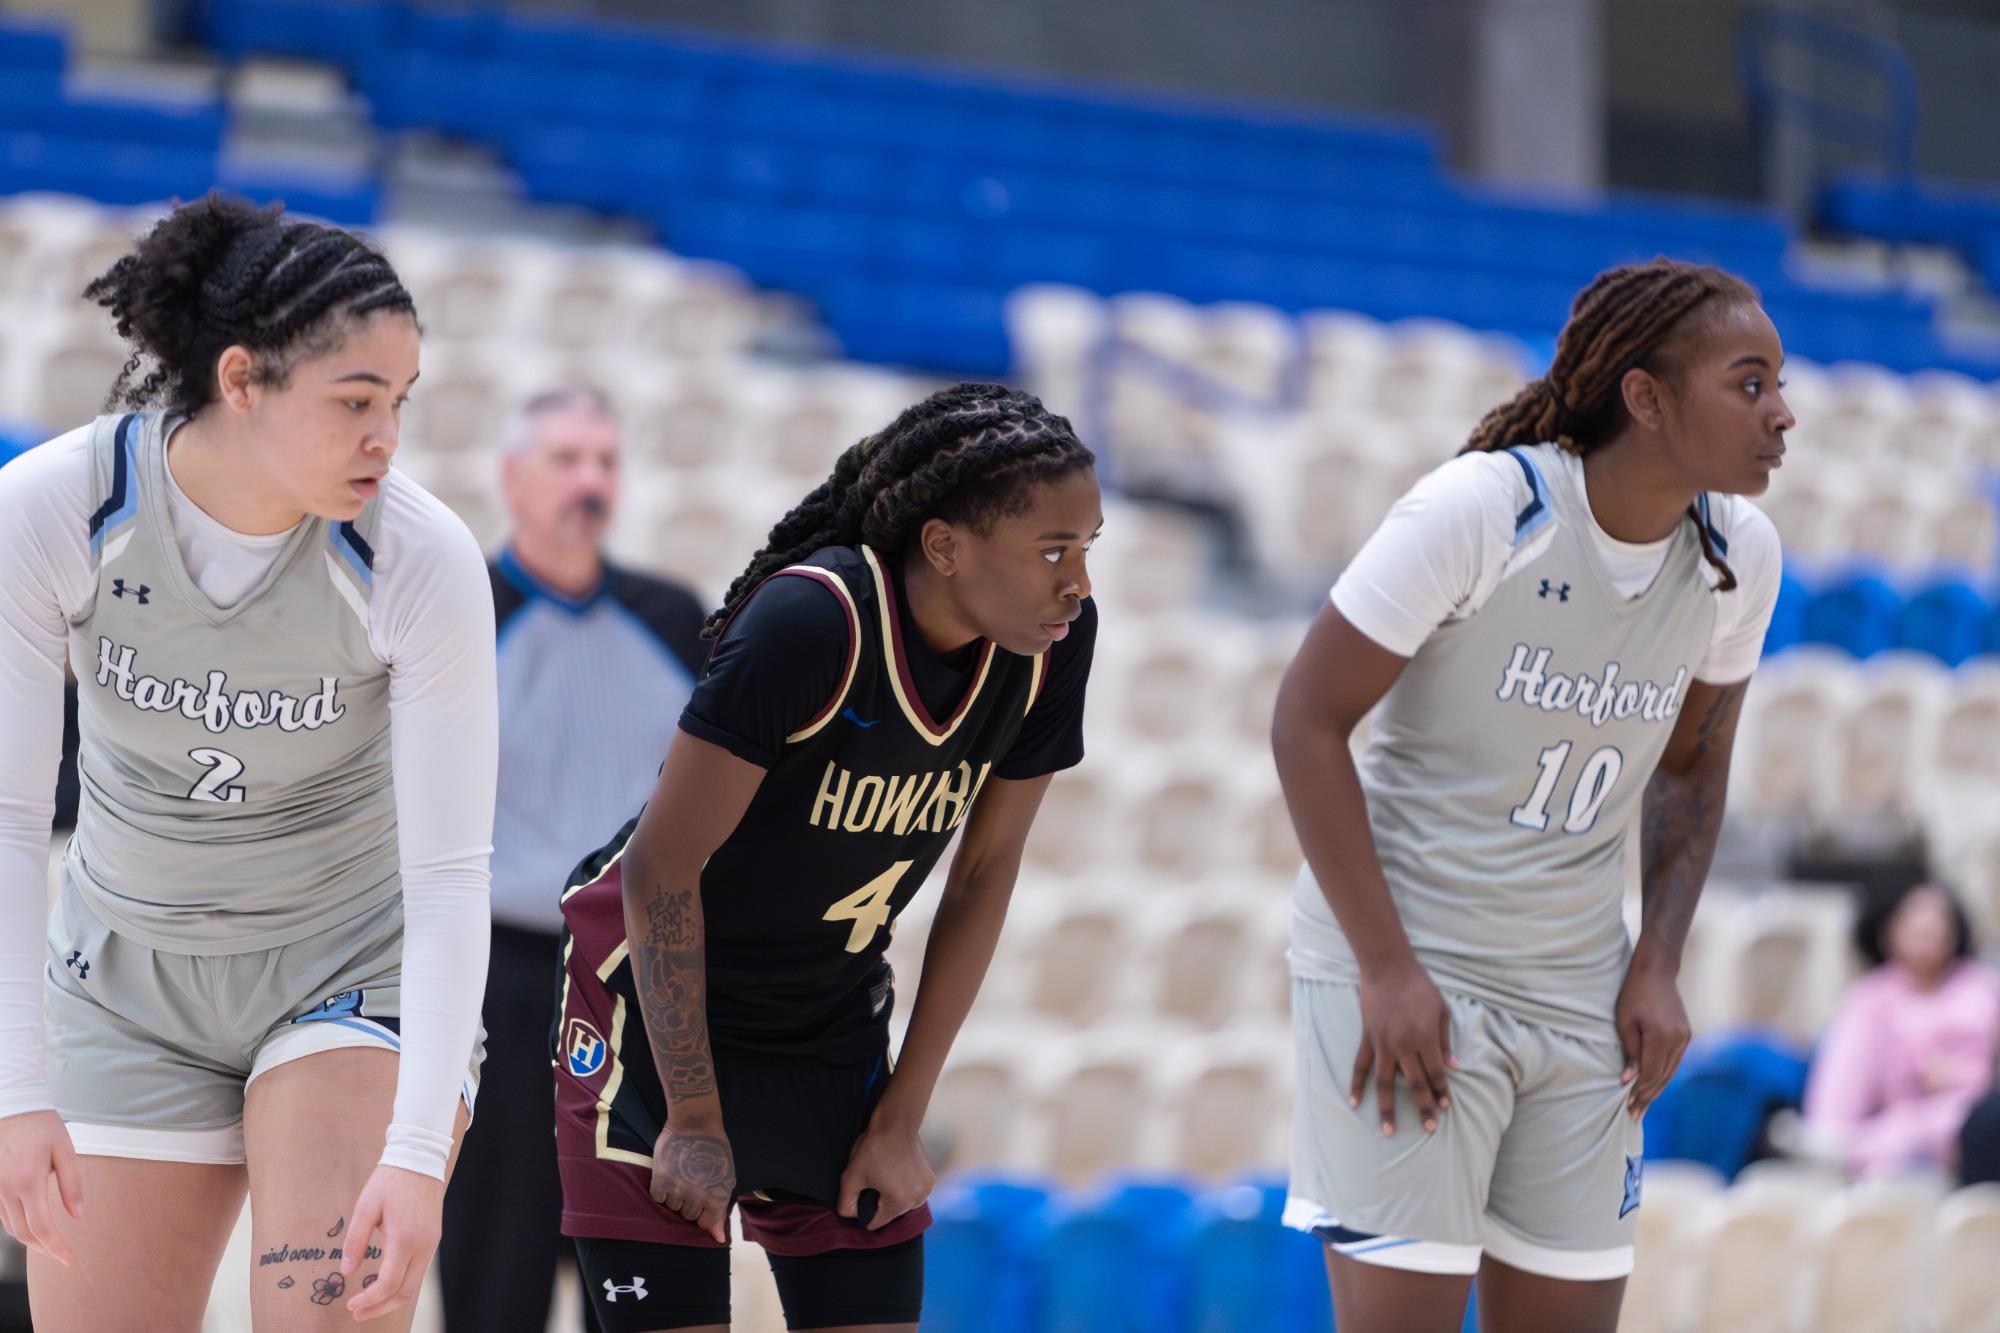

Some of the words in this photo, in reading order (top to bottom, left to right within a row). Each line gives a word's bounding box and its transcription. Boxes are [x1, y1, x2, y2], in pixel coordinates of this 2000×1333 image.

[96, 635, 346, 733] Harford
[1496, 642, 1687, 728] Harford
[187, 746, 247, 803] 2
[1509, 739, 1624, 834] 10
[821, 859, 914, 953] 4
[570, 1026, 600, 1069] H
[259, 1244, 289, 1267] mind
[289, 1247, 325, 1262] over
